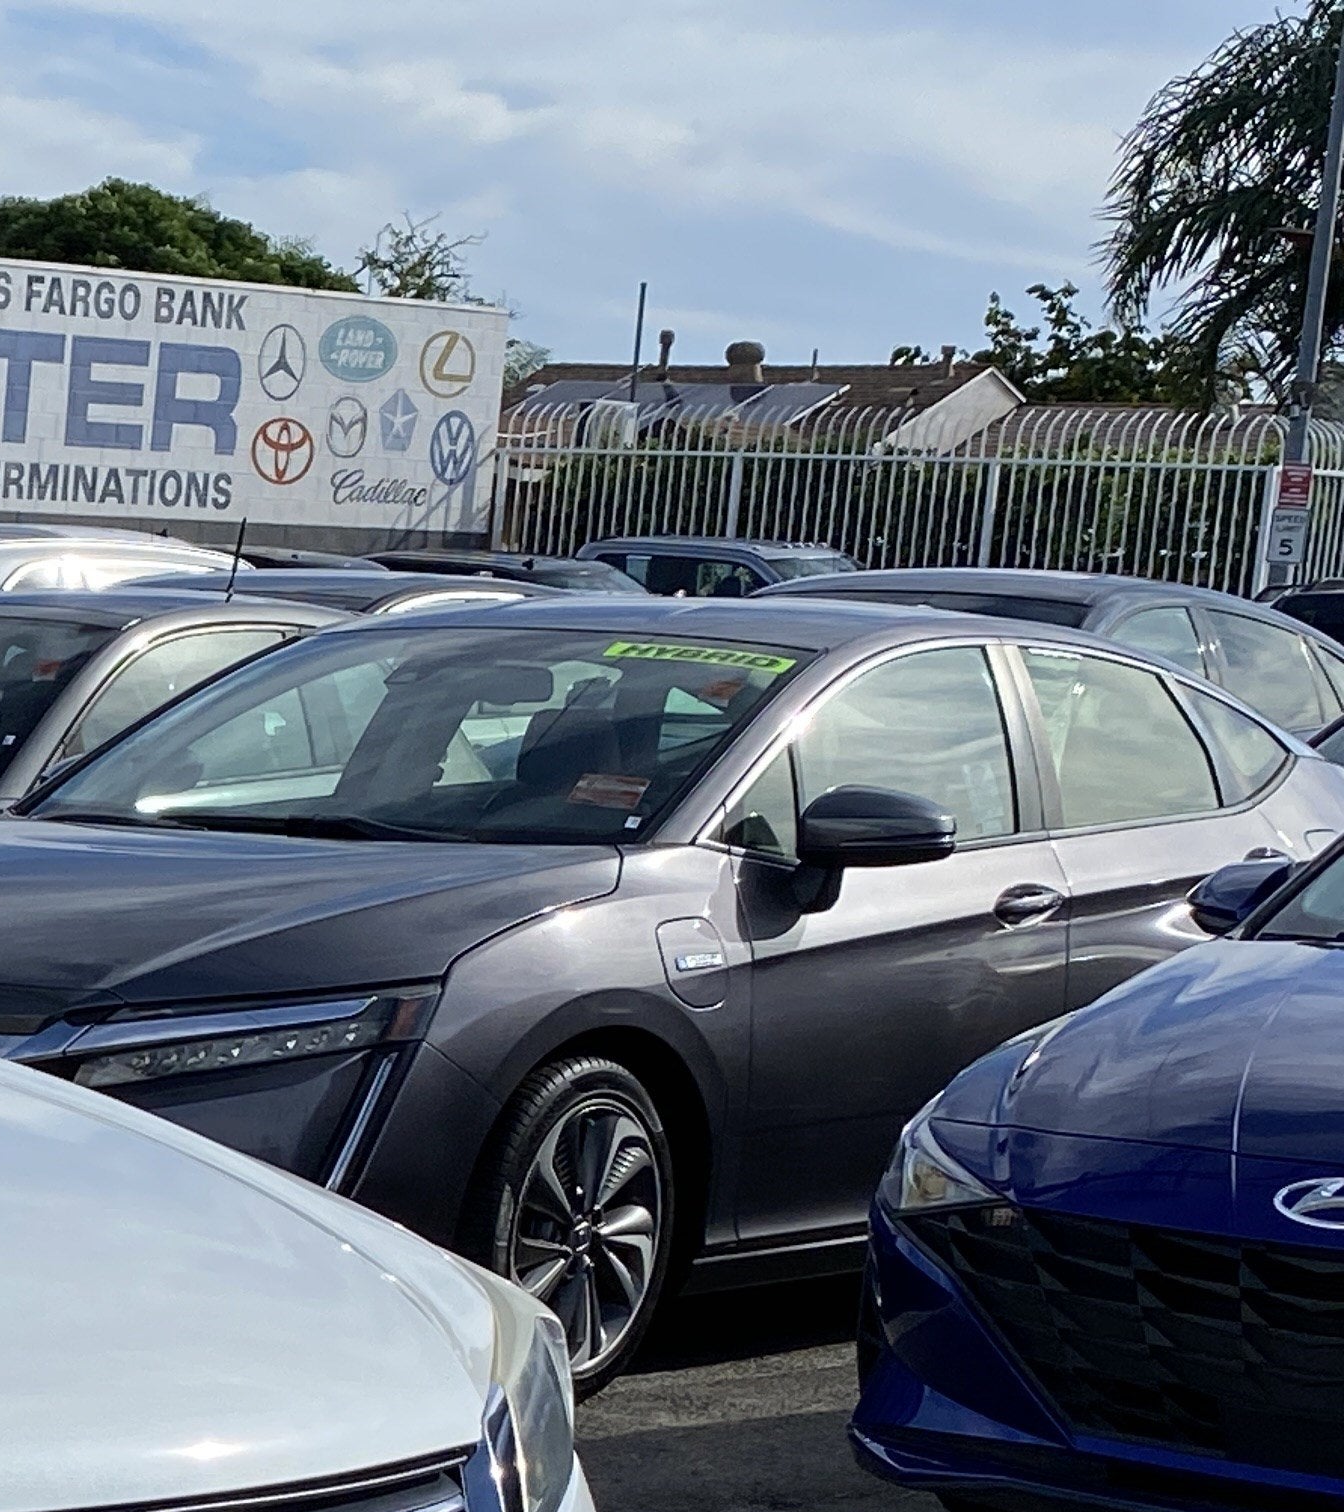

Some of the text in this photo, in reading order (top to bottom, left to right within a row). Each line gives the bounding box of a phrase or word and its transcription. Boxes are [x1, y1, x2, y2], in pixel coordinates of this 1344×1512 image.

[23, 274, 142, 322] FARGO
[152, 287, 249, 331] BANK
[330, 468, 427, 507] Cadillac
[1278, 537, 1294, 556] 5
[617, 644, 781, 668] HYBRID
